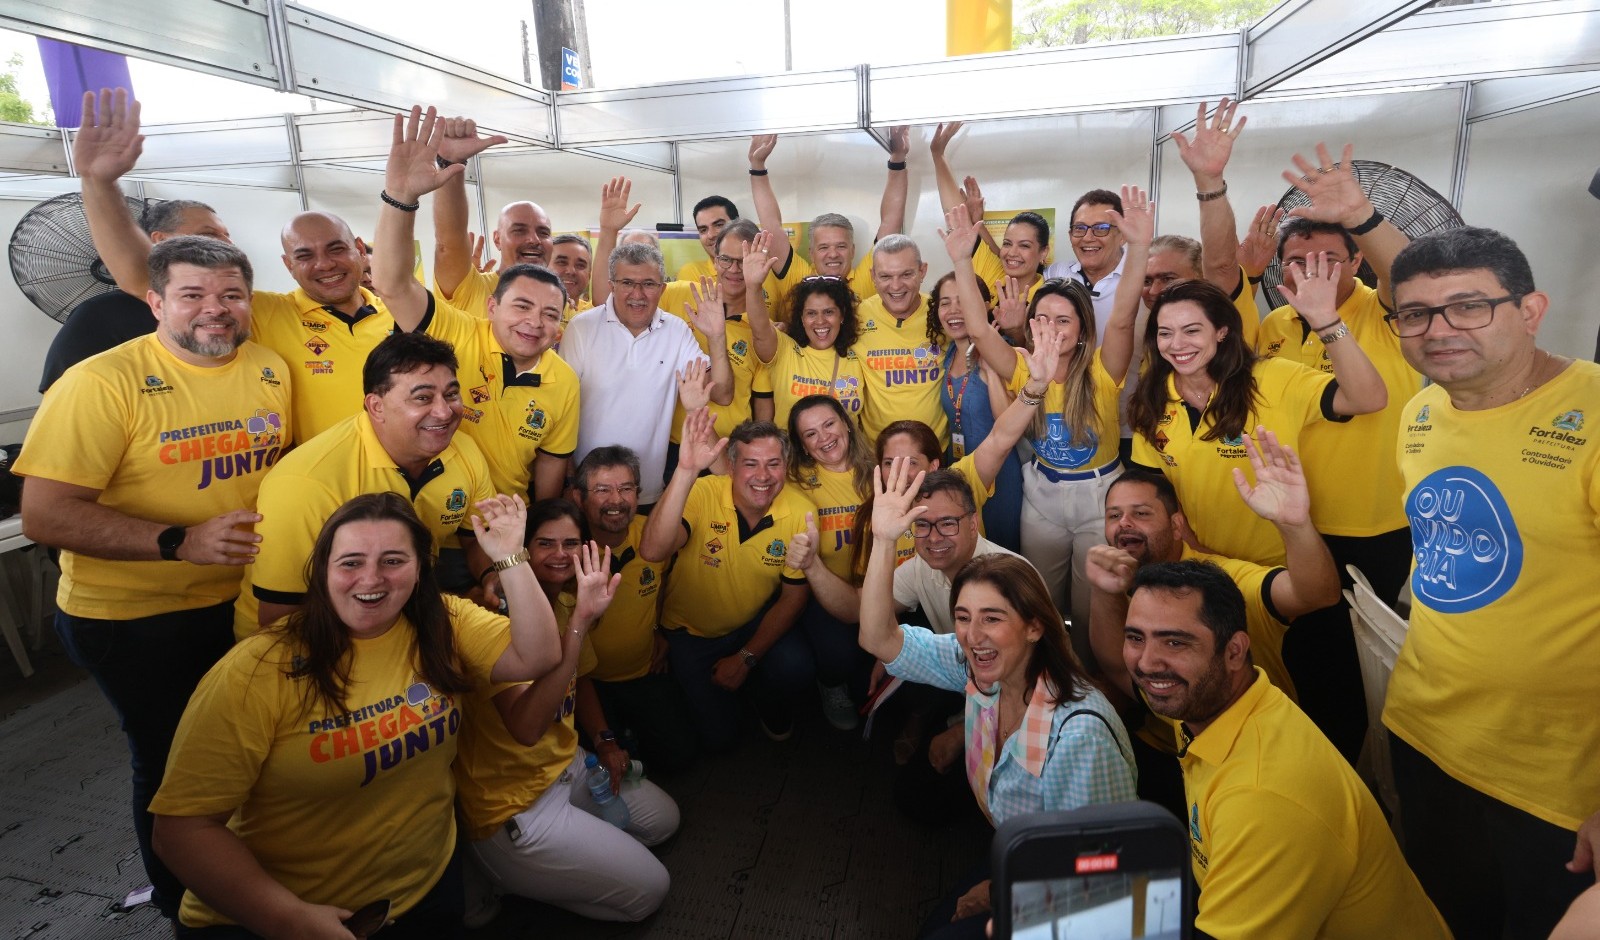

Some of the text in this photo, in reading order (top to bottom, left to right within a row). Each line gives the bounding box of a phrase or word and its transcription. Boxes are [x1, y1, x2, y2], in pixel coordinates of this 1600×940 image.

[866, 357, 916, 370] CHEGA
[867, 349, 911, 357] PREFEITURA
[793, 375, 832, 387] PREFEITURA
[885, 368, 940, 387] JUNTO
[159, 430, 250, 465] CHEGA
[160, 419, 243, 443] PREFEITURA
[1533, 438, 1575, 451] PREFEITURA
[198, 447, 280, 490] JUNTO
[1415, 486, 1465, 522] OU
[1413, 516, 1500, 563] VIDO
[309, 695, 405, 733] PREFEITURA
[310, 705, 425, 764] CHEGA
[360, 708, 460, 788] JUNTO
